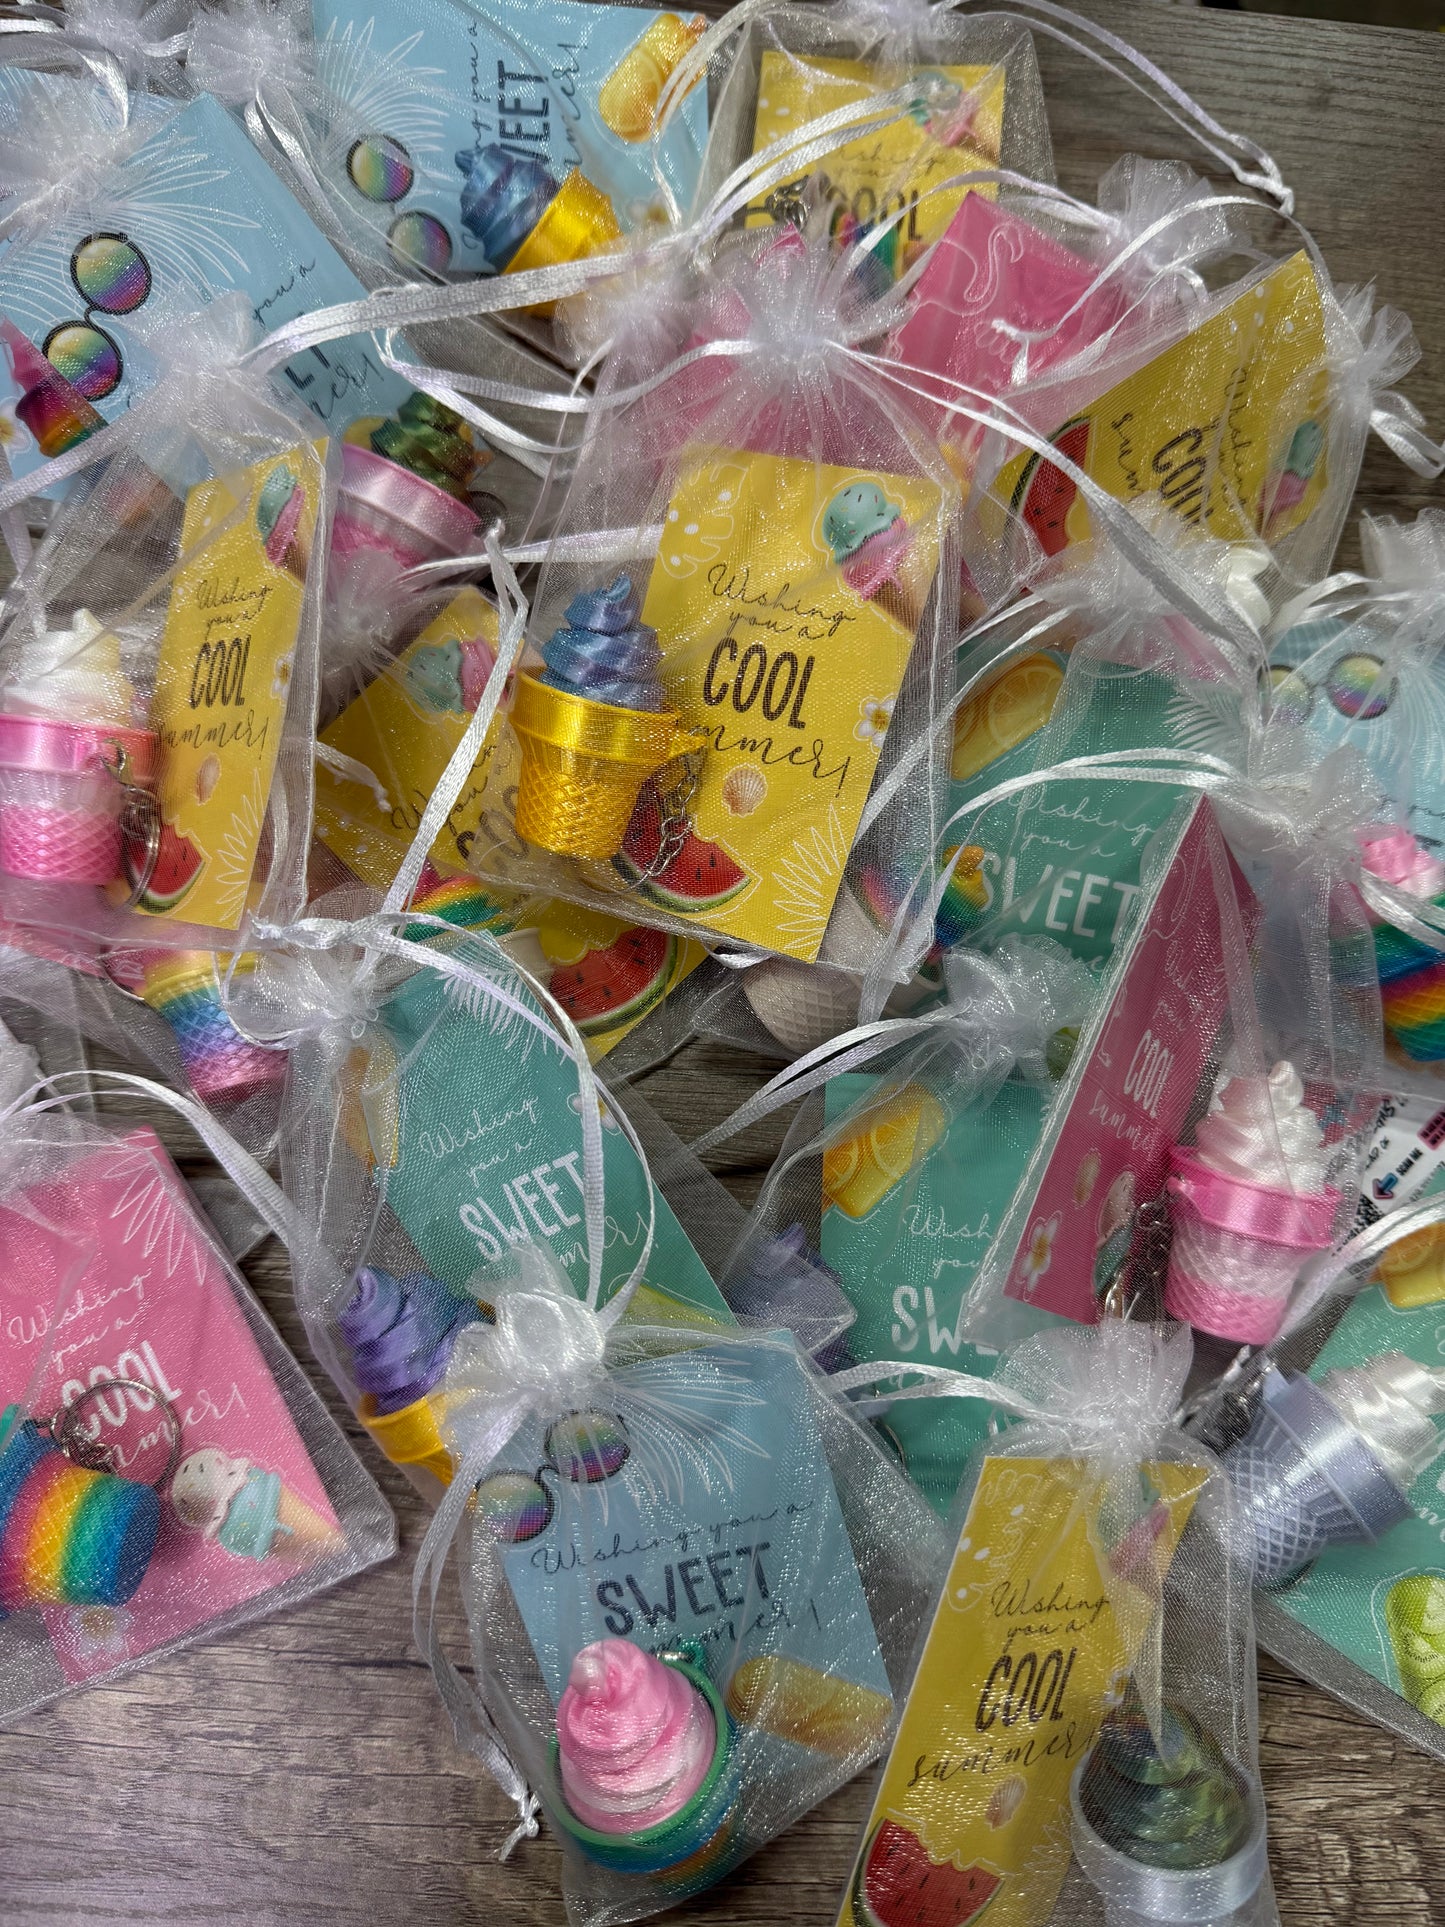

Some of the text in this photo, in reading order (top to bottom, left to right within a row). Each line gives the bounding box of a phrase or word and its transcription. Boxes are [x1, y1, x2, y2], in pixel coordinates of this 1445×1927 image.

[497, 59, 551, 166] EET
[196, 576, 273, 616] Wishing
[205, 614, 238, 641] you
[706, 563, 857, 638] Wishing
[726, 609, 824, 641] you a
[189, 633, 252, 711] COOL
[702, 636, 816, 730] COOL
[161, 708, 270, 762] ummer!
[687, 723, 851, 799] mmer!
[1006, 793, 1157, 846] Wishing
[1018, 830, 1087, 855] you
[974, 849, 1143, 945] SWEET
[1122, 1027, 1175, 1120] COOL
[418, 1095, 540, 1160] Wishing
[466, 1136, 533, 1189] you a
[1396, 1147, 1424, 1177] SCAN ME
[458, 1150, 586, 1264] SWEET
[902, 1203, 993, 1239] Wish
[6, 1270, 152, 1345] Wishing
[50, 1308, 146, 1376] you a
[60, 1340, 183, 1441] COOL
[529, 1499, 814, 1575] Wishing you a
[595, 1540, 772, 1637] SWEET
[990, 1578, 1111, 1625] Wishing
[1001, 1619, 1088, 1655] you a
[974, 1646, 1078, 1734] COOL
